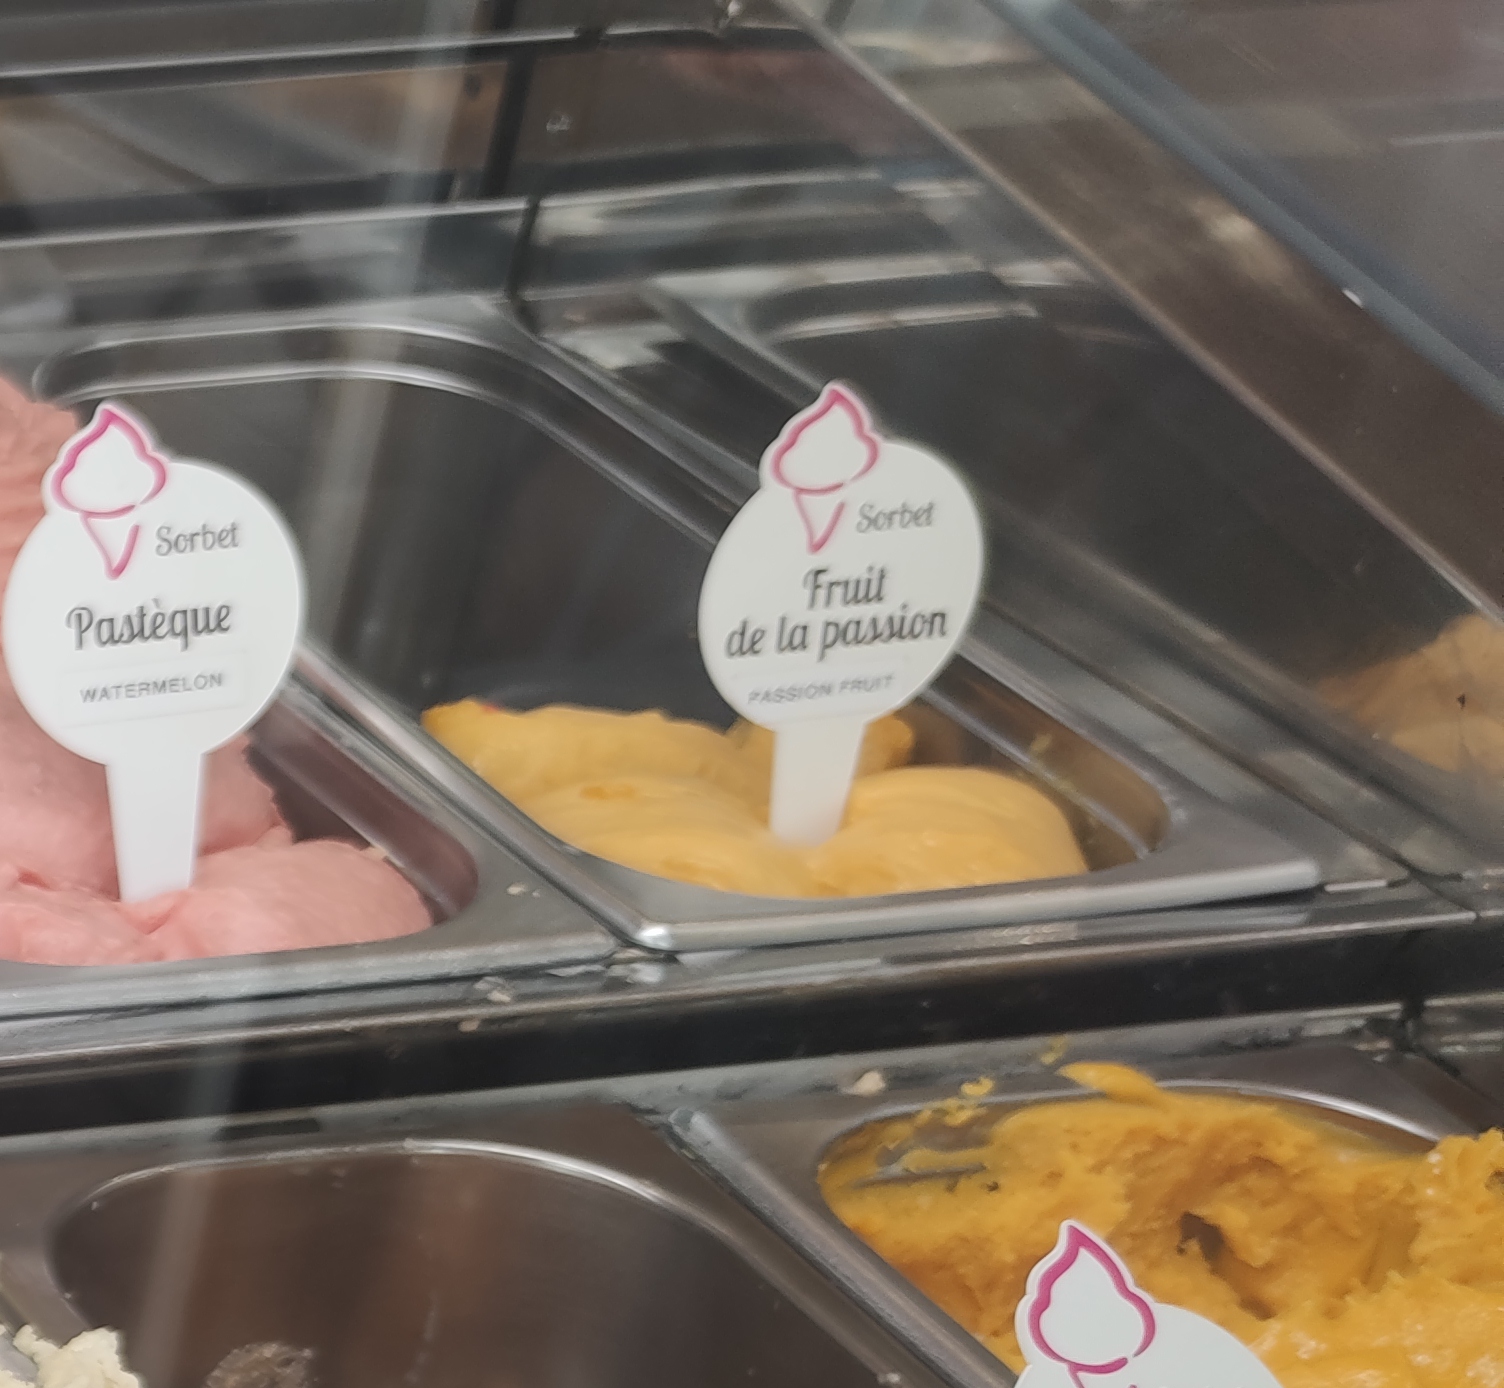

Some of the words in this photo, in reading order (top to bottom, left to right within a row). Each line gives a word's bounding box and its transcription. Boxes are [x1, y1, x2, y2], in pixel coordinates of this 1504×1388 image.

[856, 501, 935, 533] Sorbet
[154, 521, 240, 556] Sorbet
[803, 565, 888, 610] Fruit
[65, 598, 232, 652] Pastèque
[725, 620, 766, 659] de
[776, 616, 808, 654] la
[817, 603, 948, 663] passion
[80, 672, 223, 703] WATERMELON
[747, 681, 832, 705] PASSION
[838, 674, 894, 695] FRUIT
